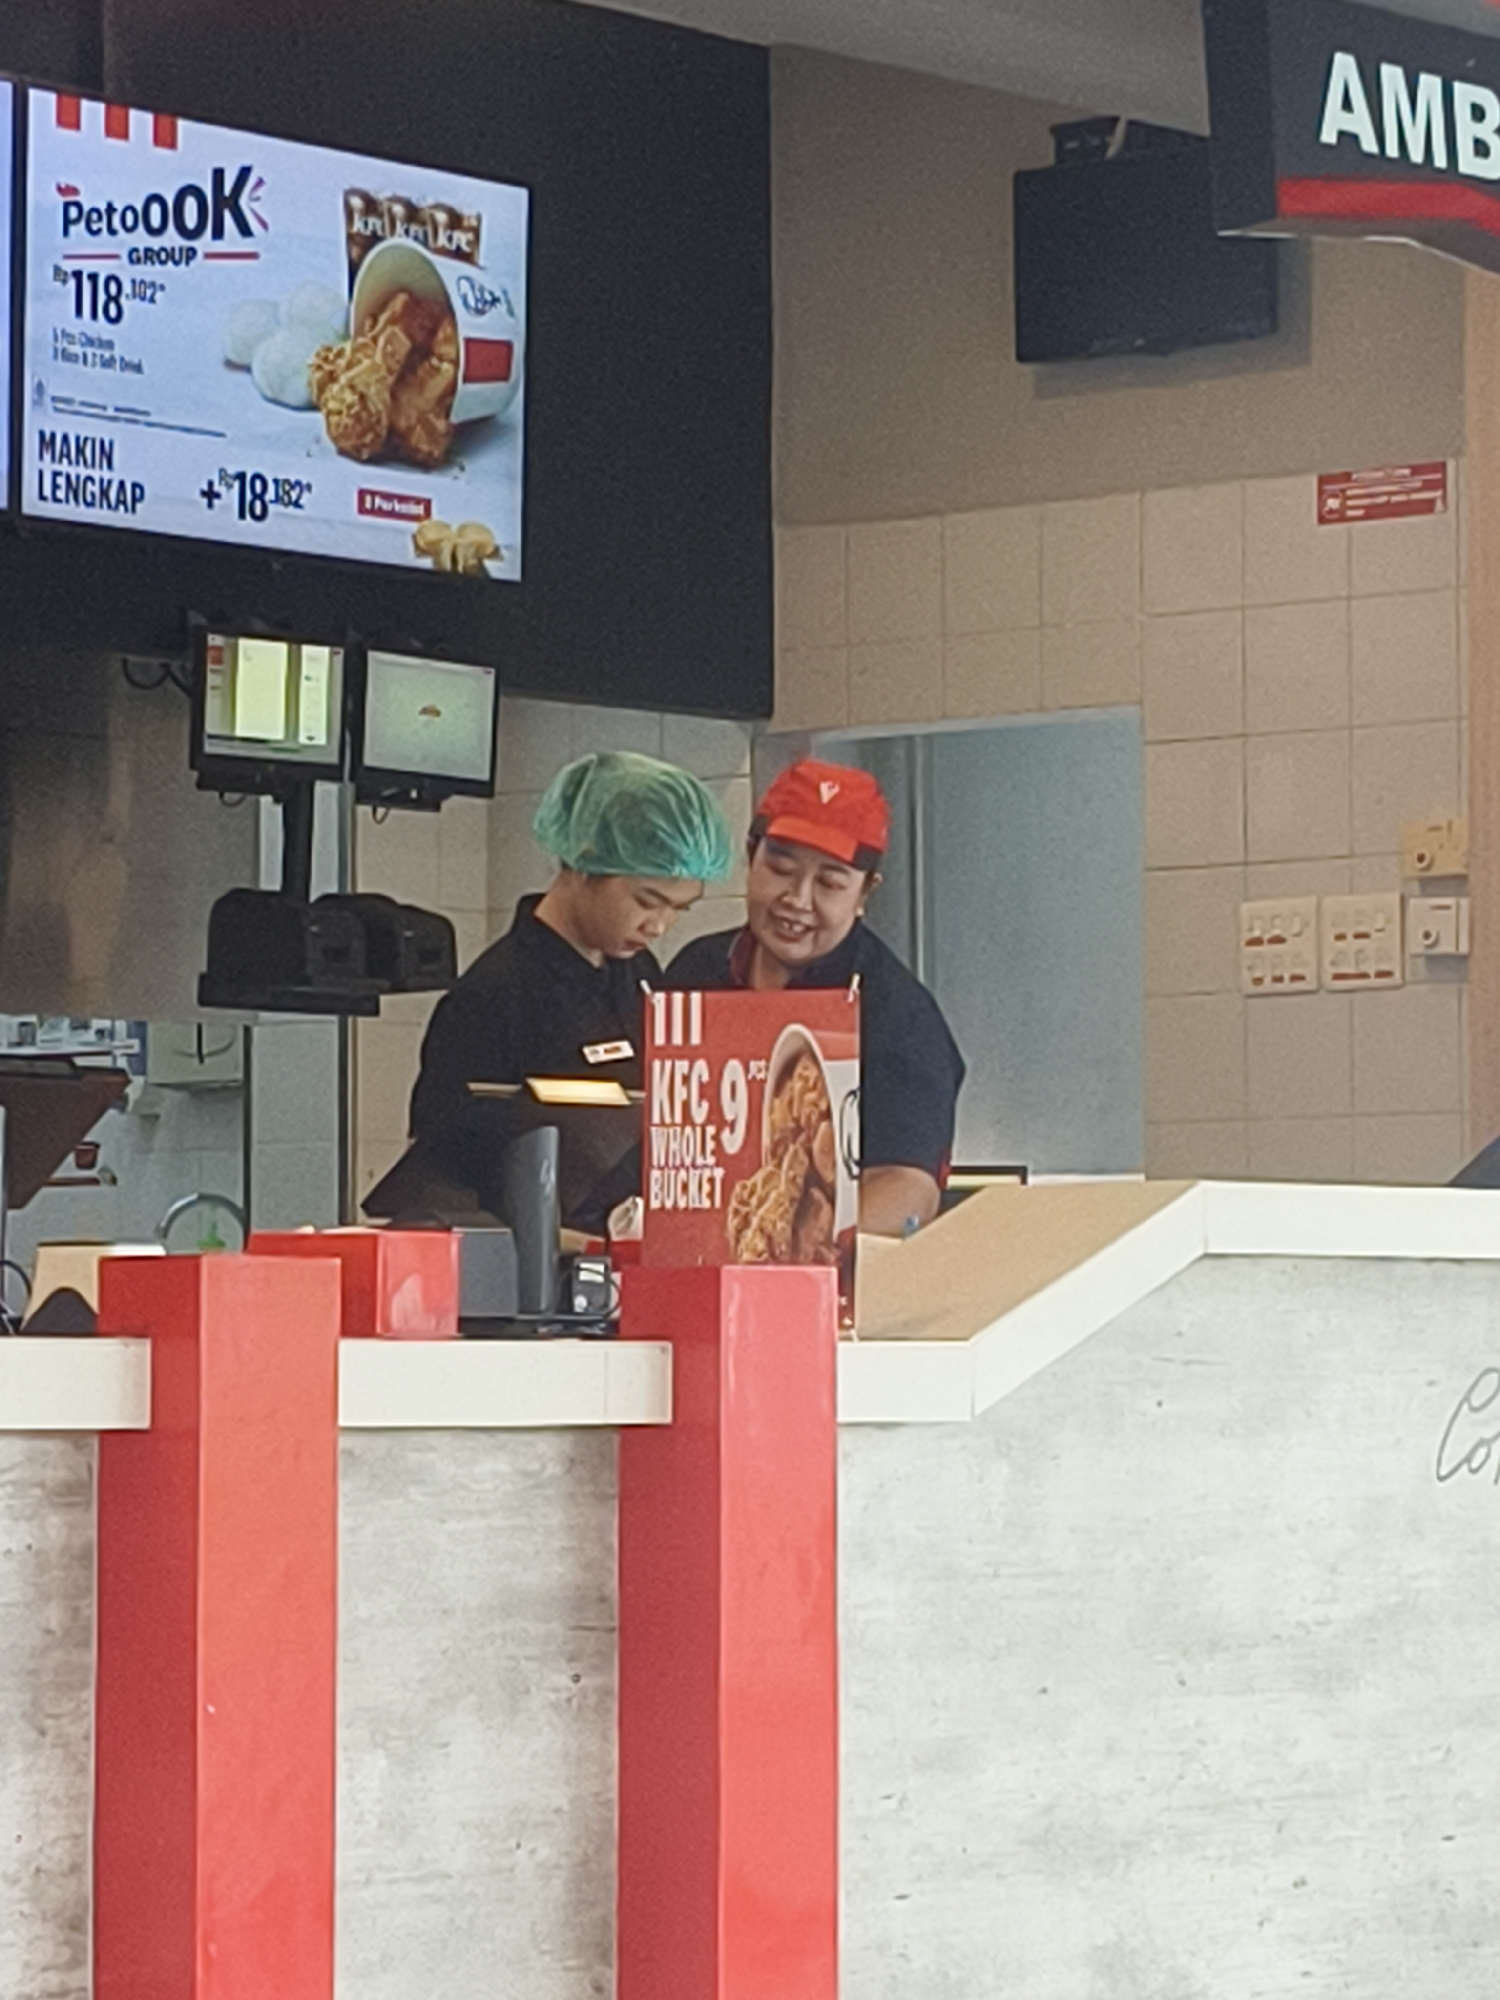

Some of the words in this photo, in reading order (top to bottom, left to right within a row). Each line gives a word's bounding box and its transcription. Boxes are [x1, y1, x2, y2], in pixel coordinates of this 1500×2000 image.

[1319, 51, 1500, 181] AMB
[127, 246, 198, 267] GROUP
[38, 429, 114, 471] MAKIN
[38, 468, 145, 514] LENGKAP
[651, 1058, 709, 1124] KFC
[720, 1059, 748, 1155] 9
[650, 1125, 716, 1168] WHOLE
[650, 1167, 725, 1210] BUCKET
